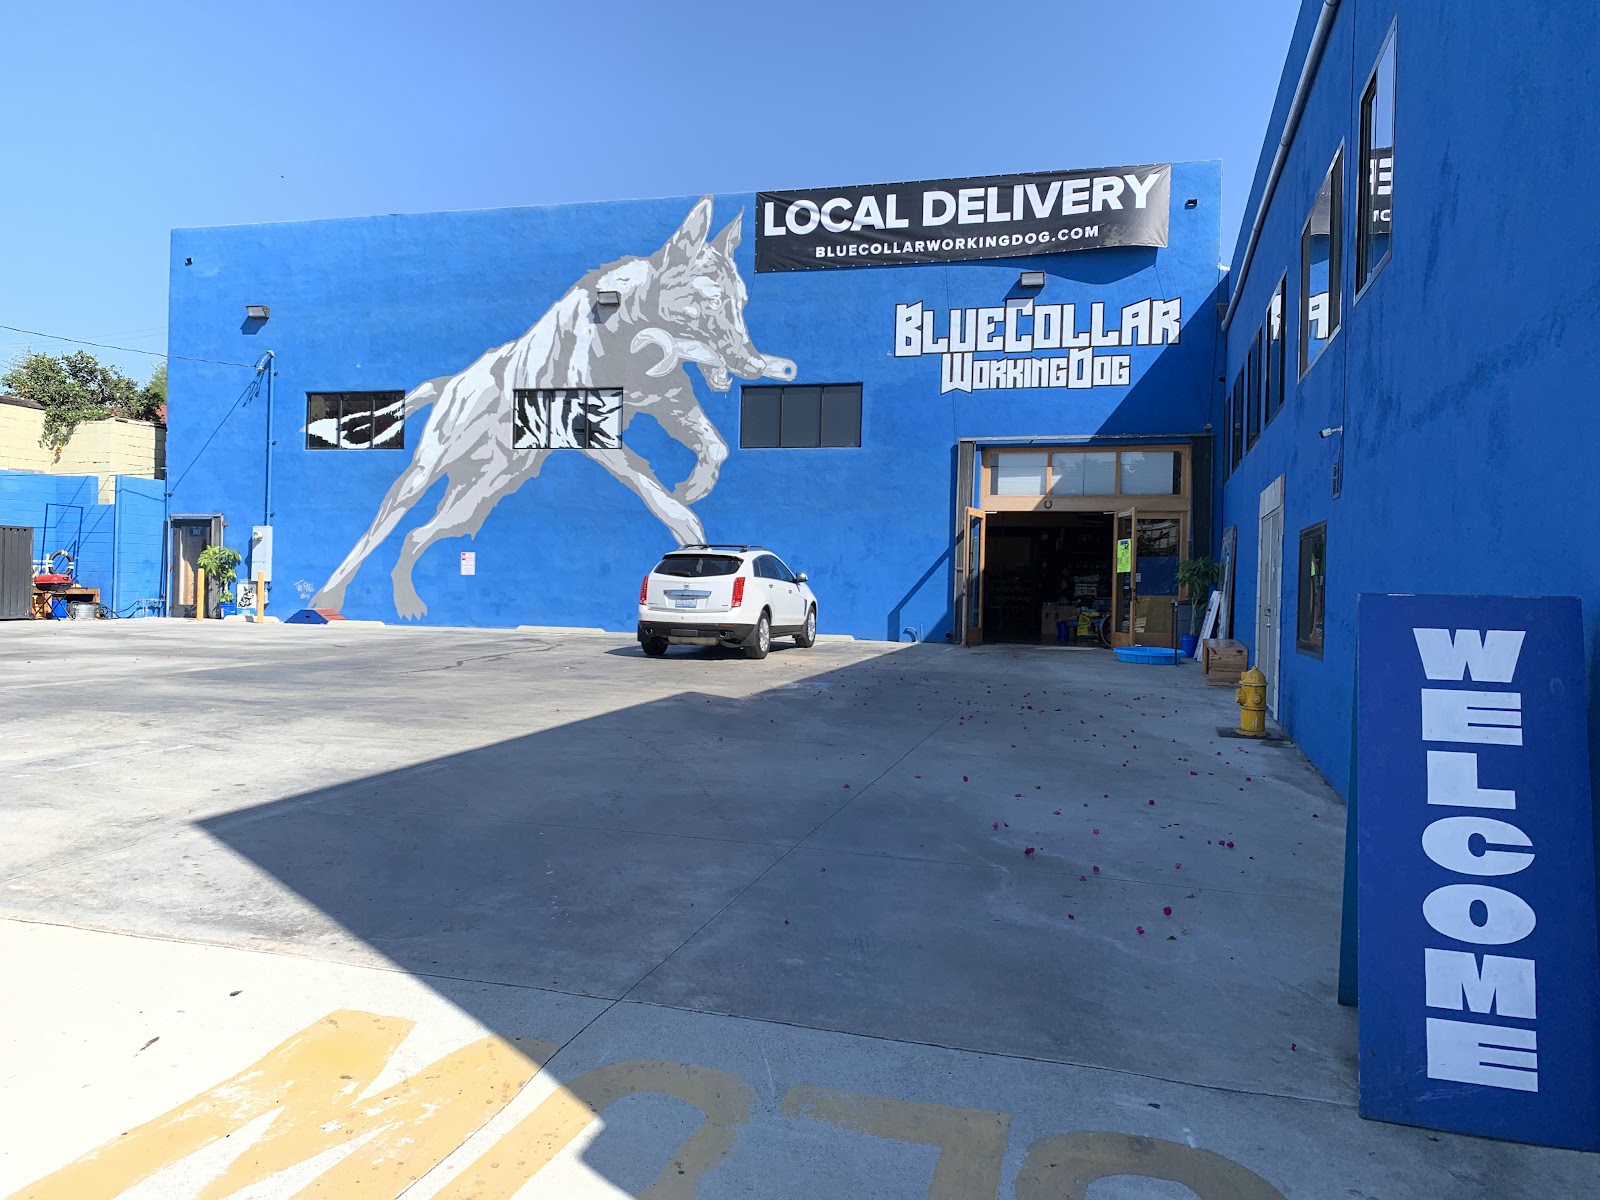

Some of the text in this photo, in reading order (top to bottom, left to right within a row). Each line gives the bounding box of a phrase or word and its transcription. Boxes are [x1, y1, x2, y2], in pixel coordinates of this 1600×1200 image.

[763, 173, 1161, 237] LOCAL DELIVERY
[815, 224, 1099, 258] BLUECOLLARWORKINGDOG.COM
[1412, 627, 1539, 1093] WELCOME
